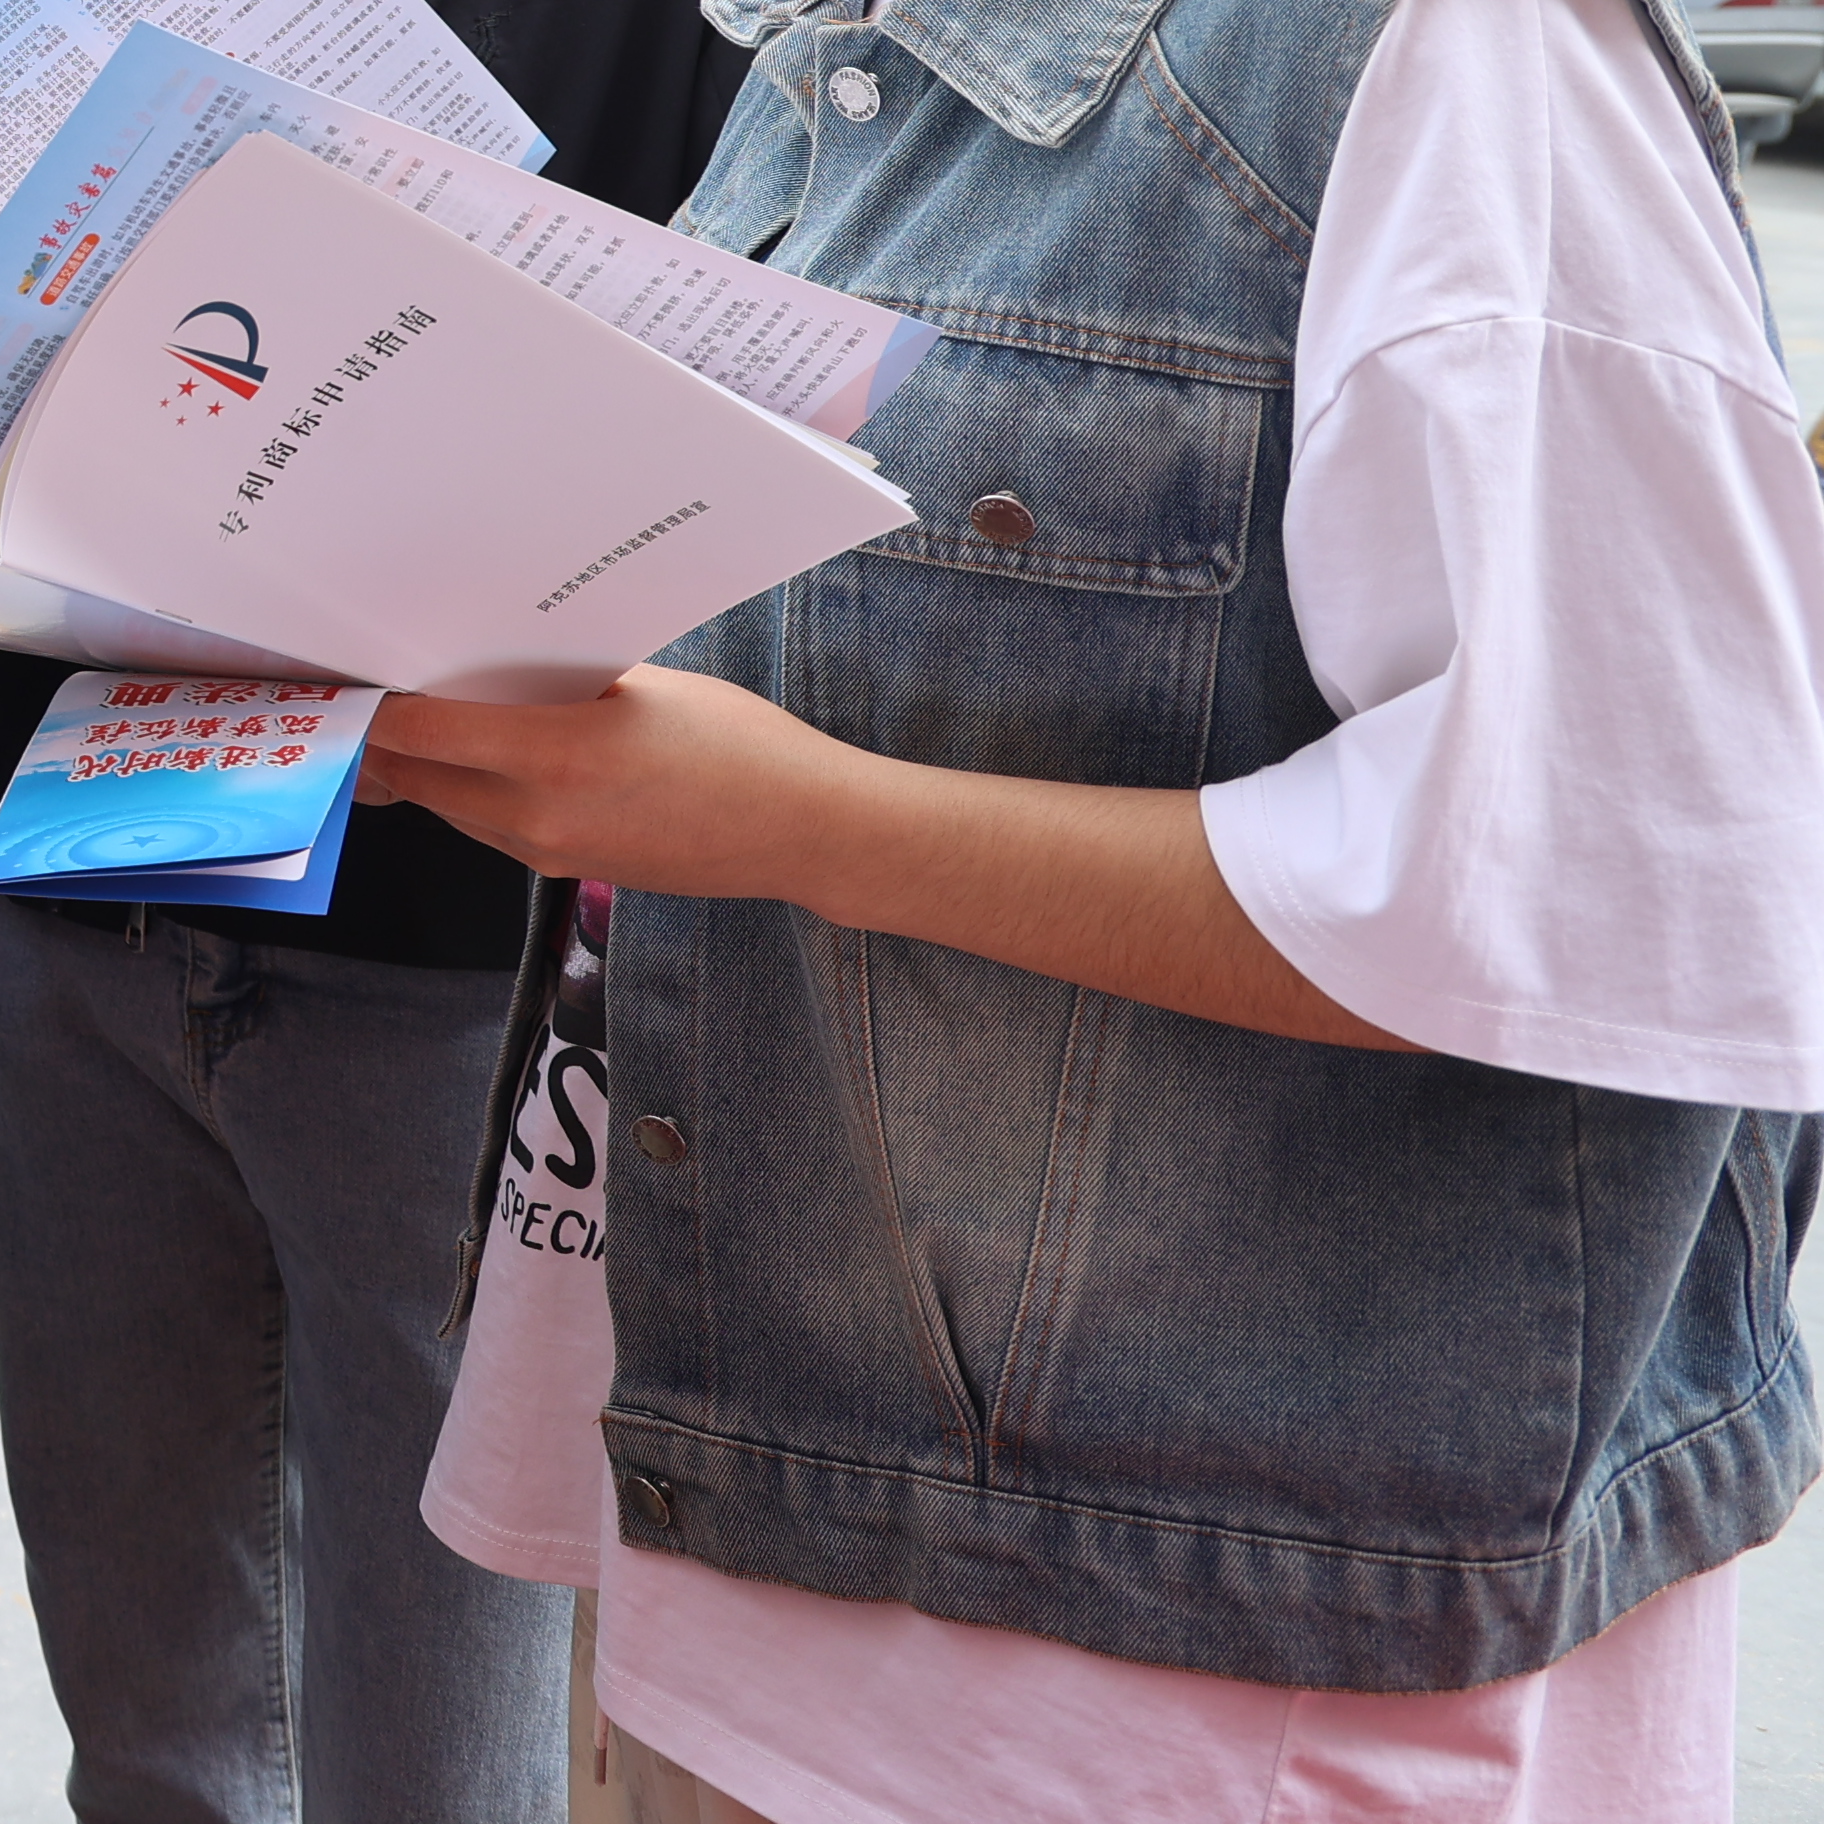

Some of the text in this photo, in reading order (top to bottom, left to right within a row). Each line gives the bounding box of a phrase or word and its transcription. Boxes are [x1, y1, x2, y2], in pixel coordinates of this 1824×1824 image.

[839, 71, 876, 96] FASHION
[35, 159, 118, 254] 事故灾害篇
[45, 240, 95, 297] 道路交通事故
[218, 304, 438, 544] 专利商标申请指南
[537, 499, 711, 614] 阿克苏地区市场监督管理局宣
[103, 680, 342, 708] 民法典
[83, 712, 325, 745] 筑梦新征程
[69, 741, 312, 780] 奋进新时代
